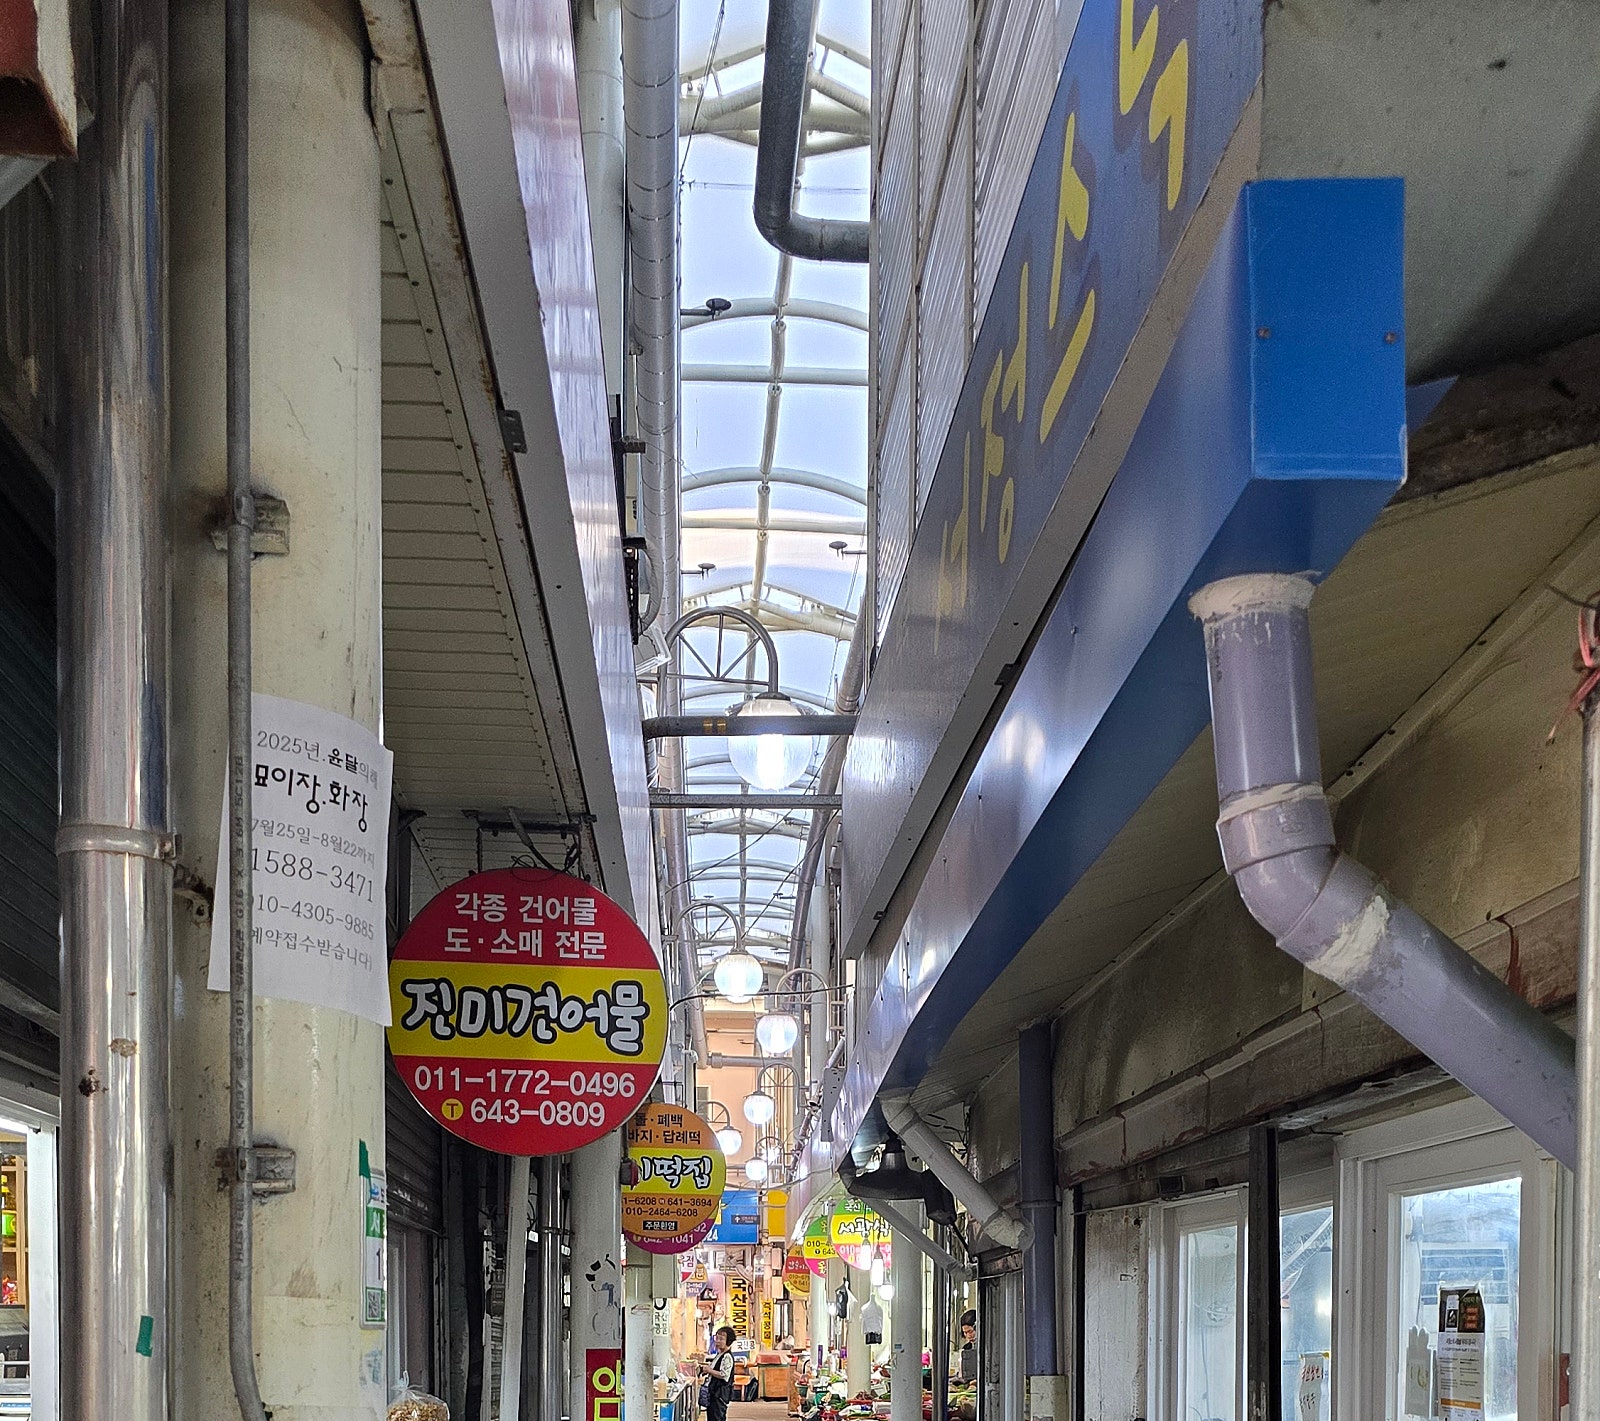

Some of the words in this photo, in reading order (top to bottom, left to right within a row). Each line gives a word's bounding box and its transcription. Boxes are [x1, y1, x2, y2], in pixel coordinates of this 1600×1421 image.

[252, 848, 373, 903] 1588-3471
[252, 894, 375, 941] 10-4305-9885
[455, 893, 507, 923] 각종
[519, 895, 598, 926] 건어물
[555, 932, 607, 960] 전문
[400, 977, 649, 1056] 진미건어물
[415, 1066, 635, 1097] 011-1772-0496
[471, 1098, 605, 1127] 643-0809
[628, 1129, 701, 1144] 바지·답례떡
[622, 1196, 656, 1205] 1-6208
